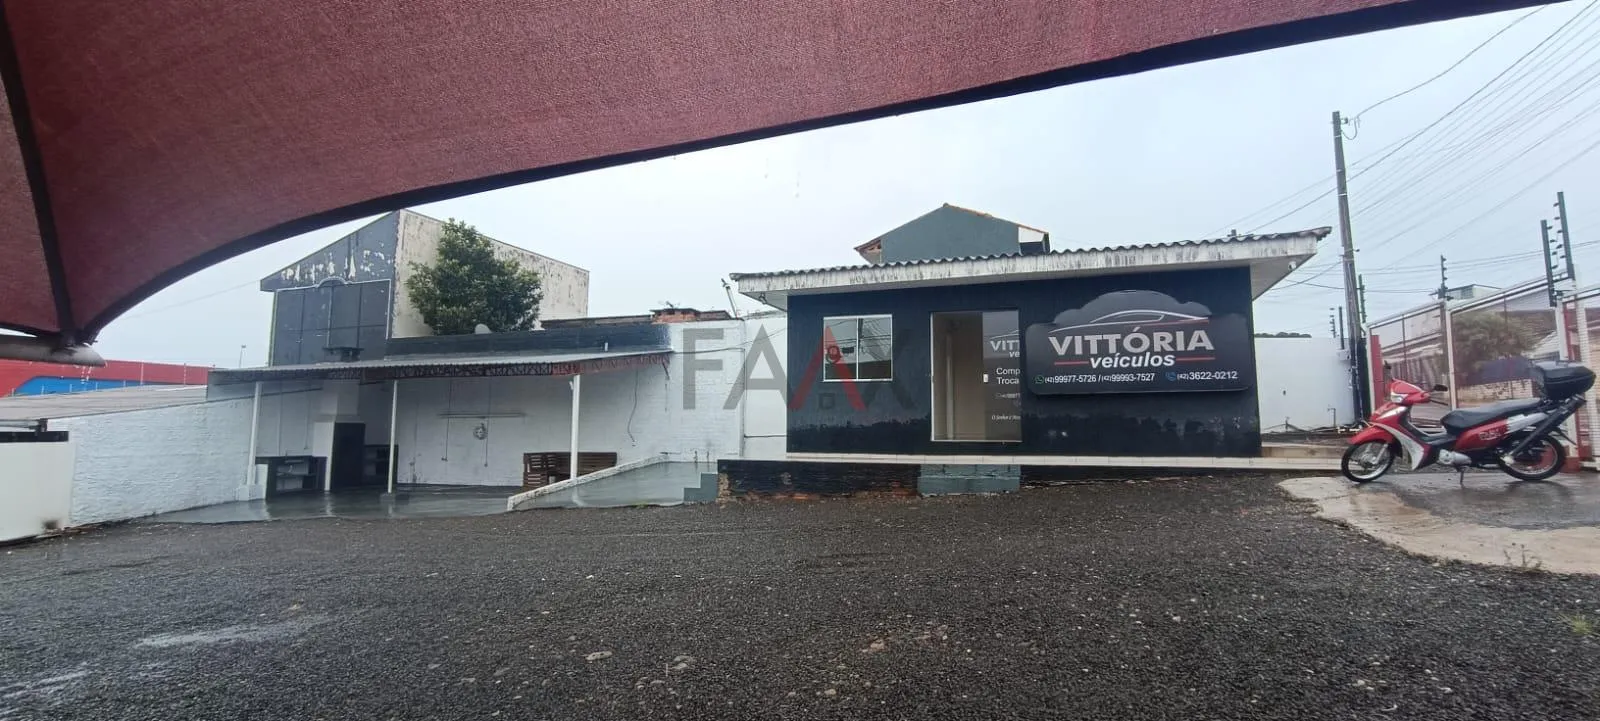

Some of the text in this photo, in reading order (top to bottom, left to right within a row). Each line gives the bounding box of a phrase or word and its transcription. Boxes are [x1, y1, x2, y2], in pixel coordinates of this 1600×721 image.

[1048, 327, 1215, 356] VITTÓRIA
[1090, 351, 1176, 369] veículos
[996, 376, 1020, 385] Troca
